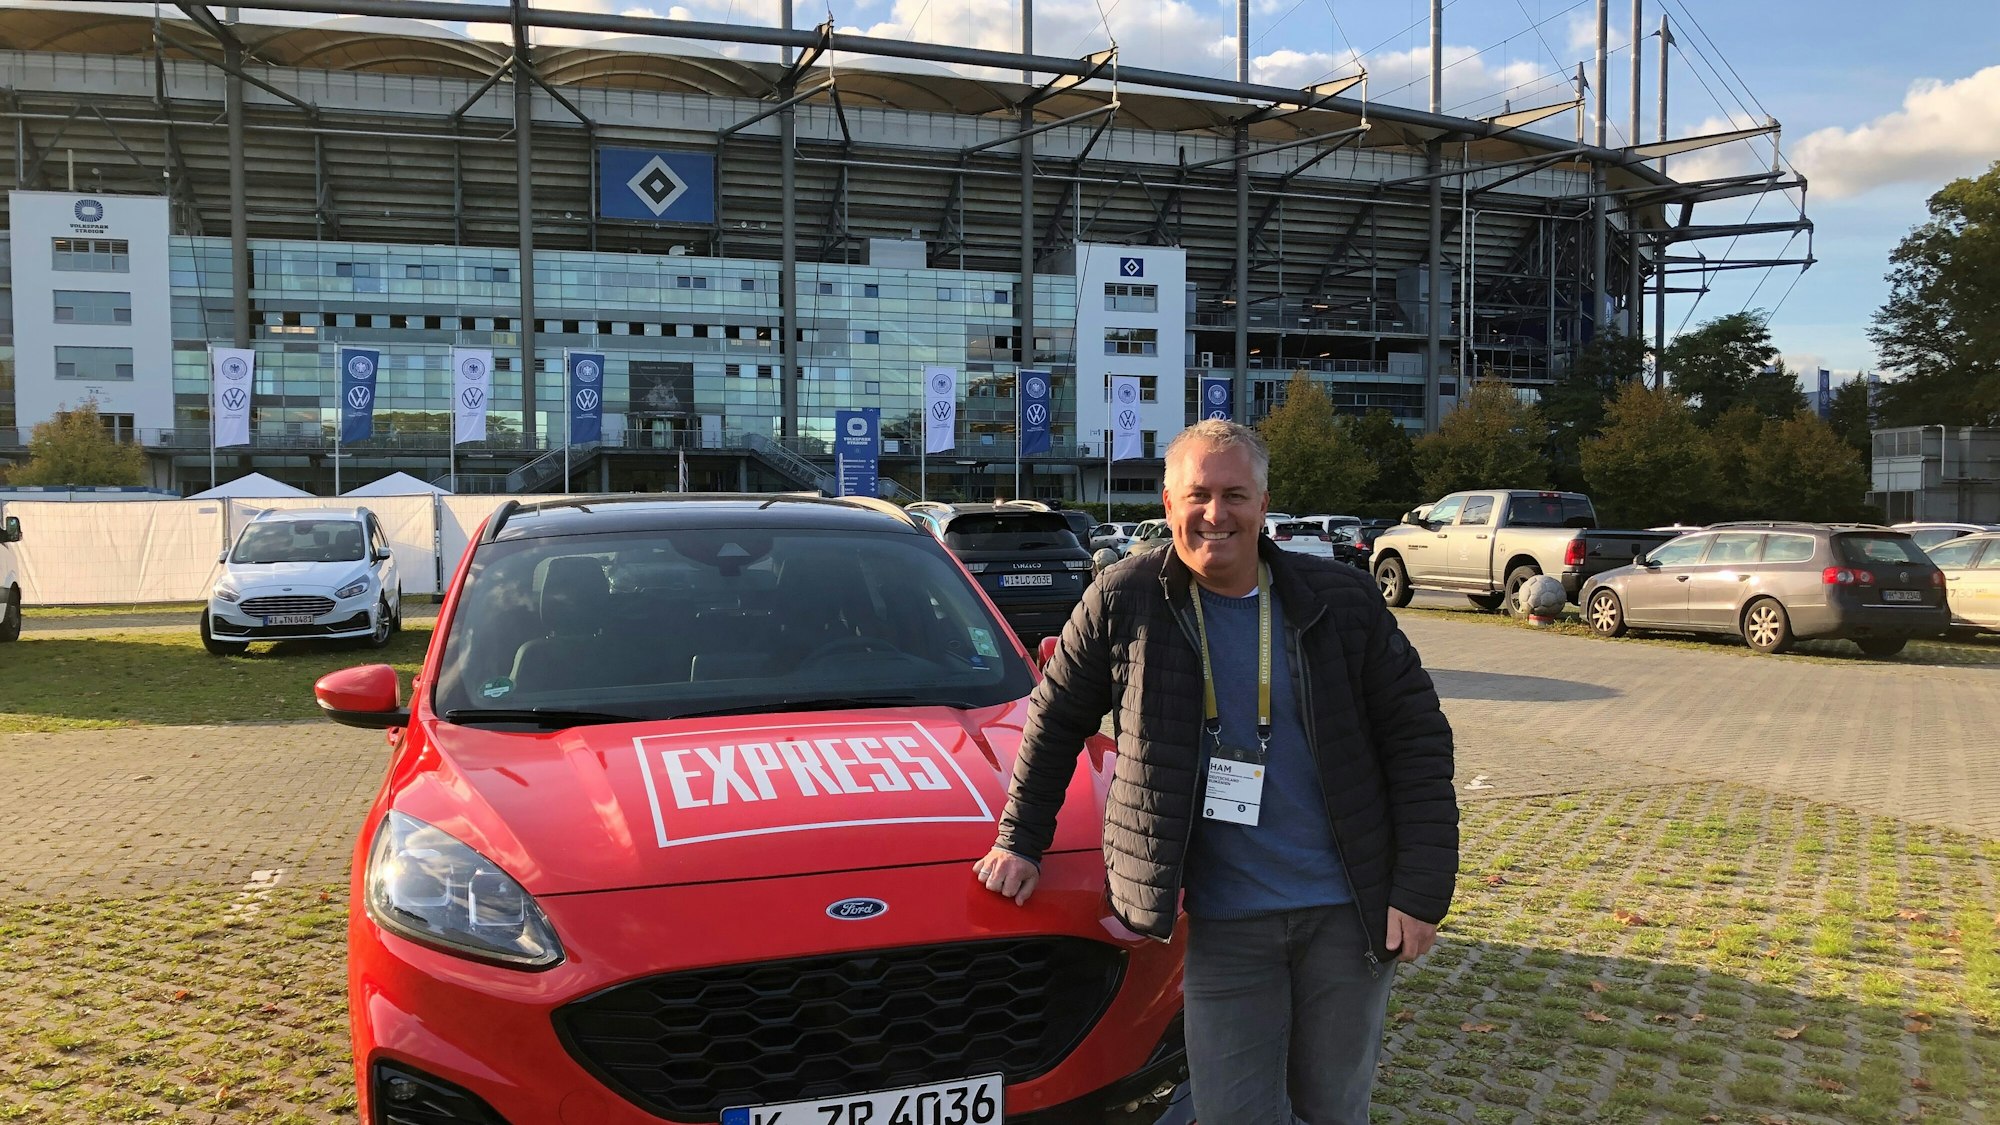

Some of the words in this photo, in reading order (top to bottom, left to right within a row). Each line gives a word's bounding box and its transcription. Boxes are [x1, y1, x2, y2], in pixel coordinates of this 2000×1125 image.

[661, 736, 952, 809] EXPRESS
[1209, 775, 1240, 783] DEUTSCHLAND
[1210, 763, 1232, 773] HAM
[888, 1083, 996, 1125] 4036
